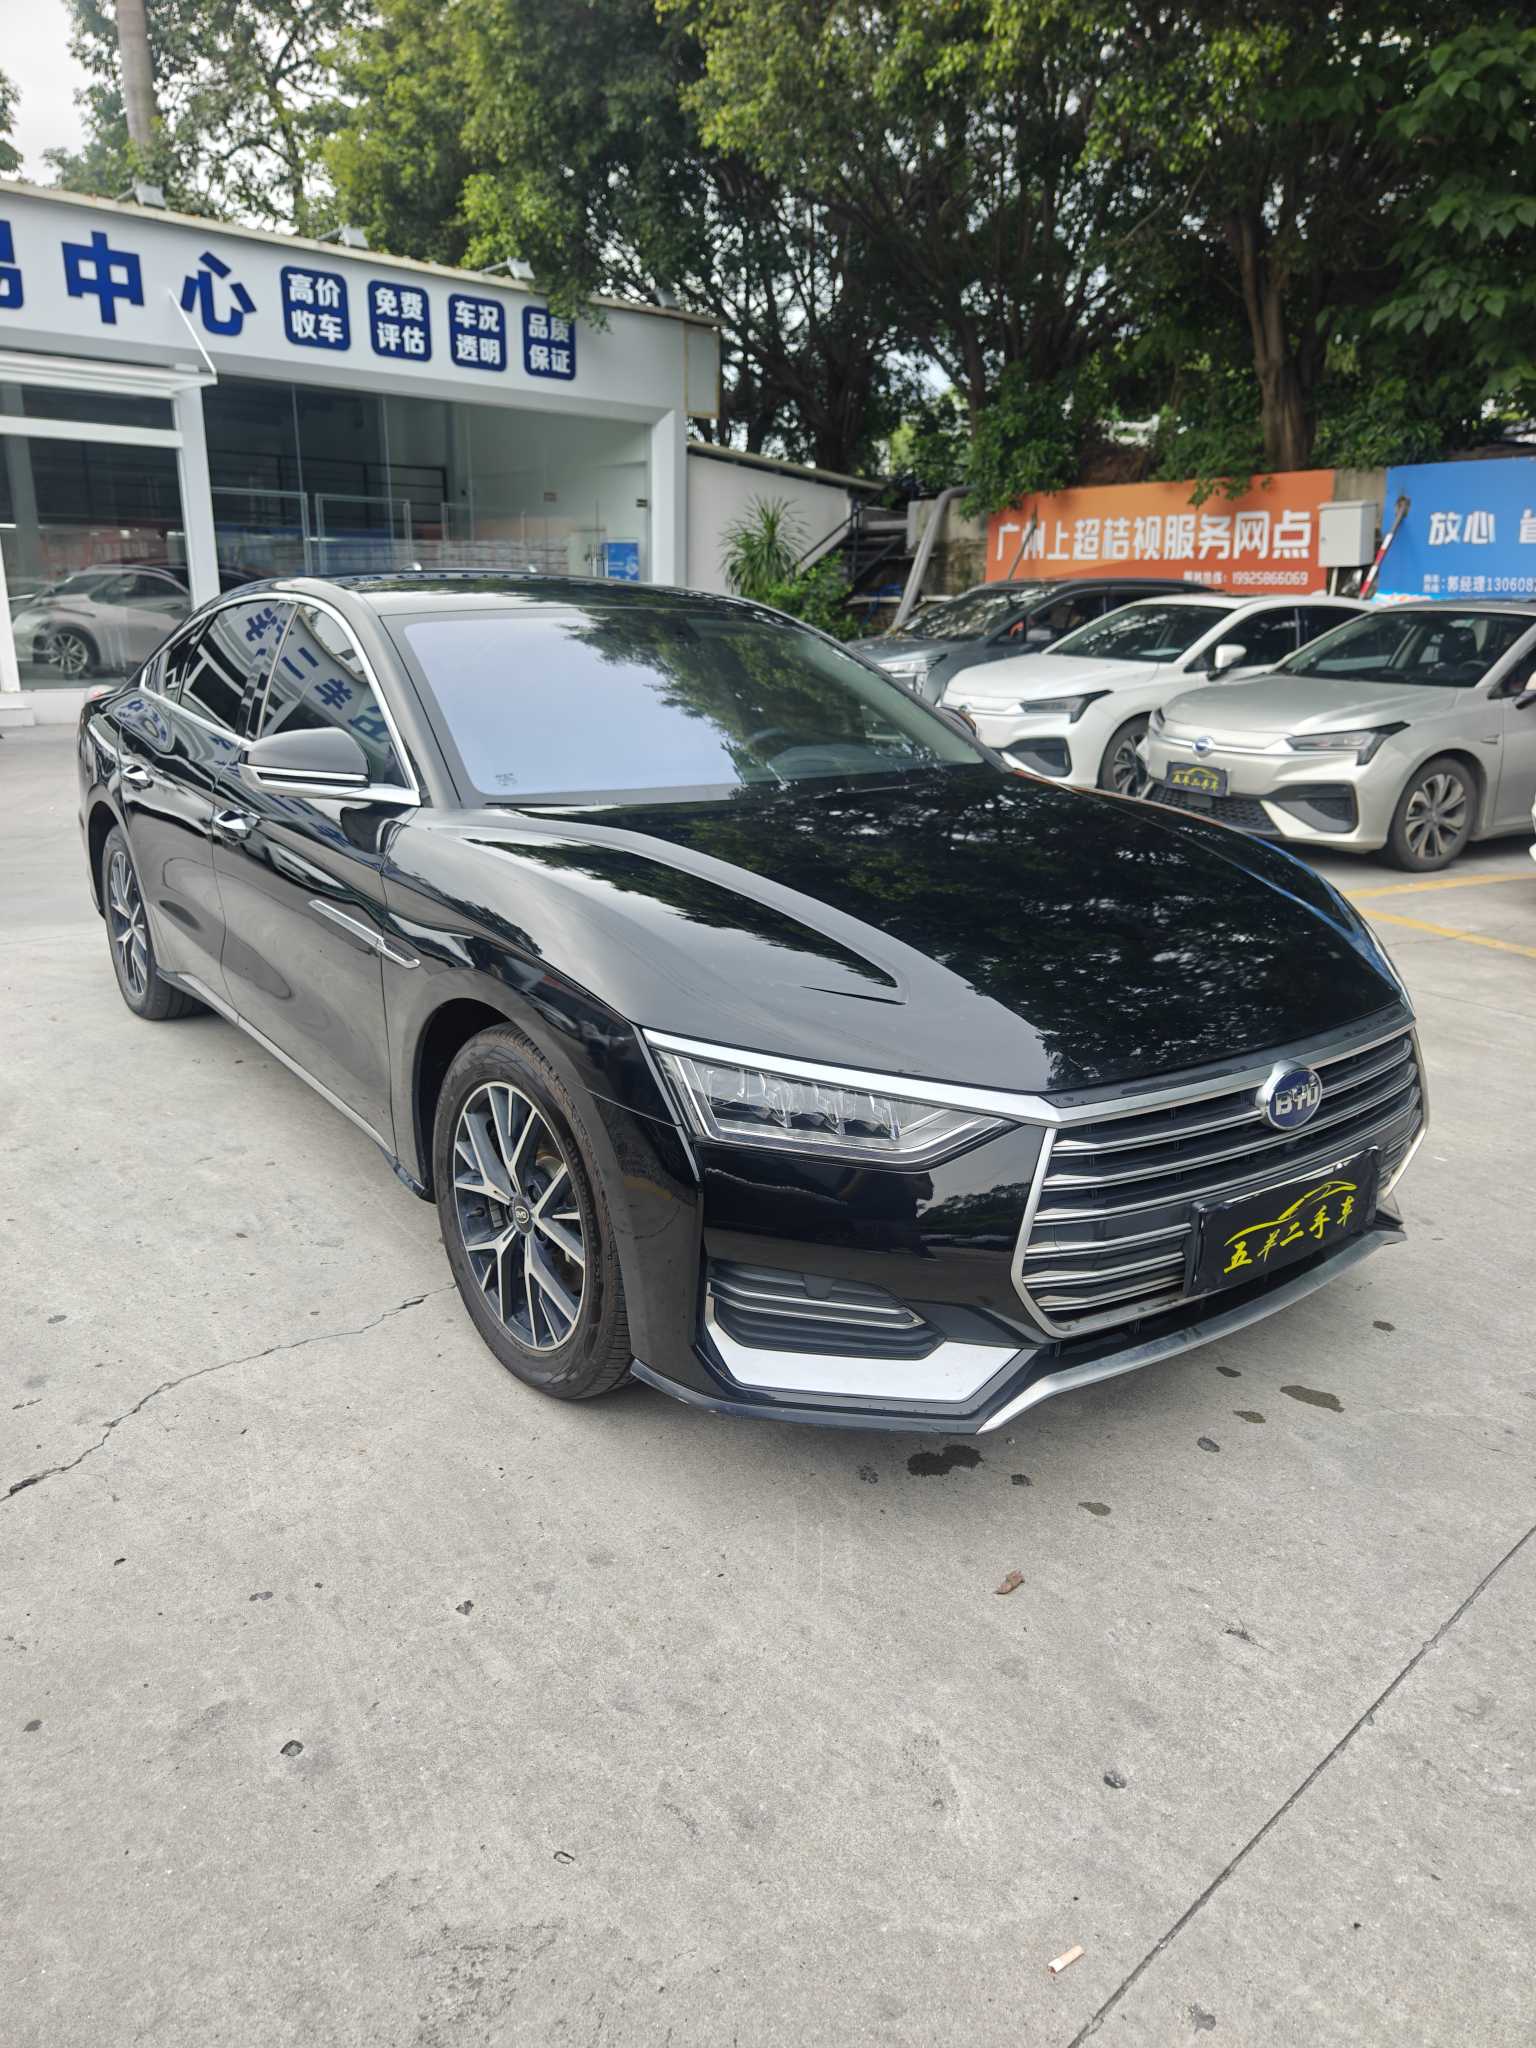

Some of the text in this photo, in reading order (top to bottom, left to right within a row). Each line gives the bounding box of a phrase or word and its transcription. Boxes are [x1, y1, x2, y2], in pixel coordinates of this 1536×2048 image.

[287, 274, 341, 309] 高价
[375, 287, 424, 322] 免费
[292, 310, 344, 343] 收车
[454, 301, 500, 333] 车况
[528, 313, 570, 343] 品质
[377, 322, 425, 354] 评估
[456, 334, 500, 365] 透明
[529, 345, 571, 374] 保证
[1428, 511, 1496, 546] 放心
[1275, 1084, 1319, 1116] BYD
